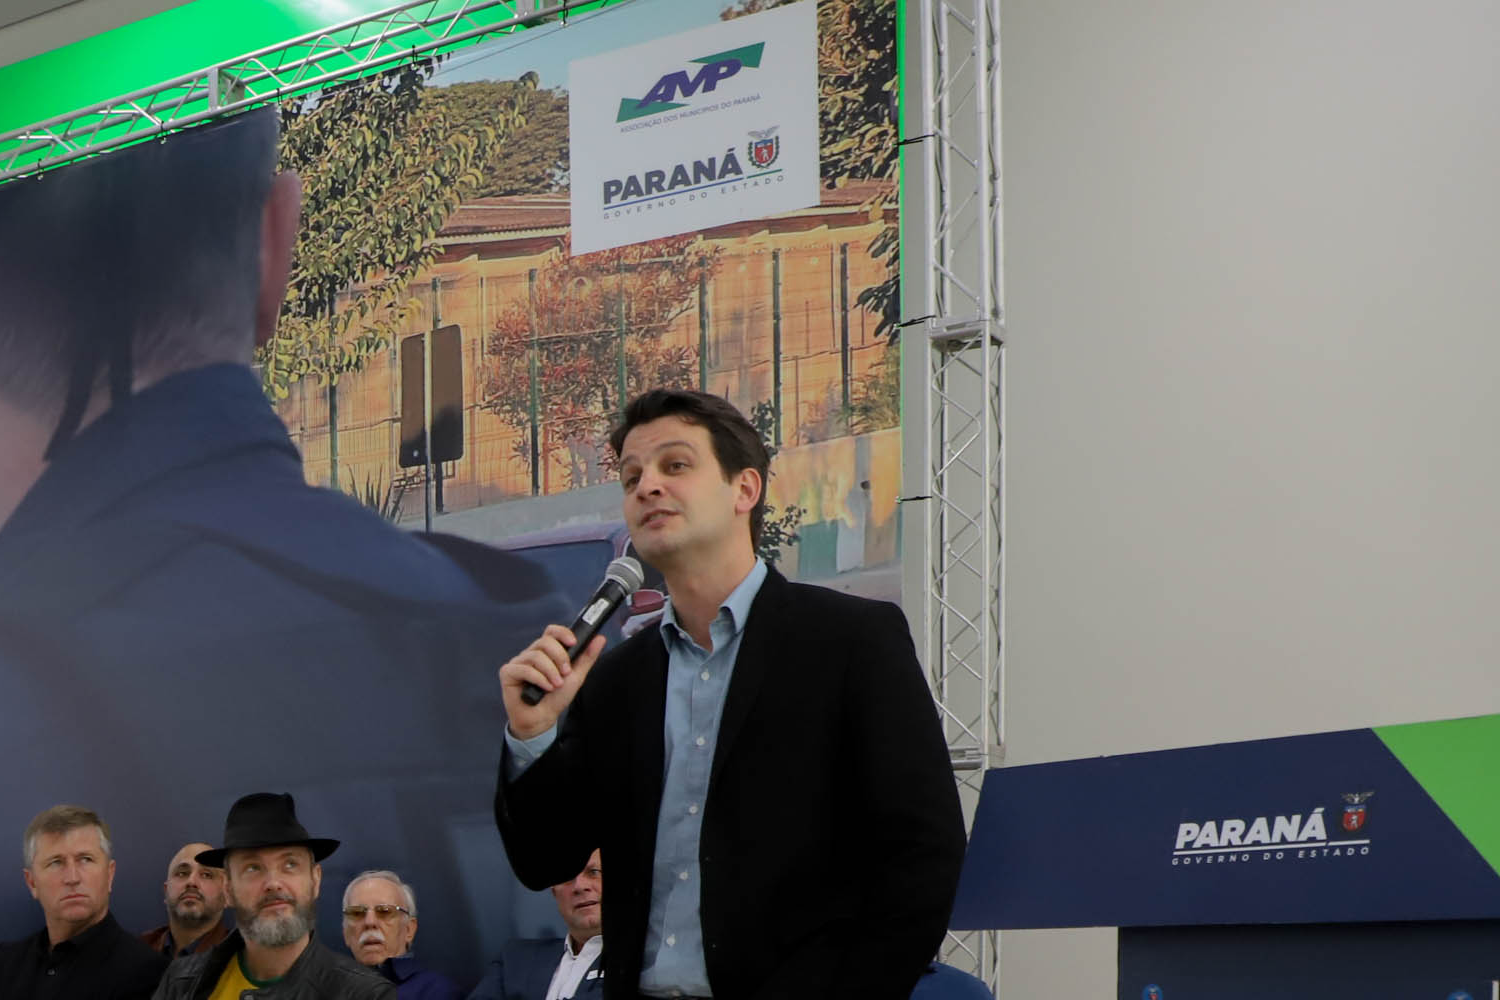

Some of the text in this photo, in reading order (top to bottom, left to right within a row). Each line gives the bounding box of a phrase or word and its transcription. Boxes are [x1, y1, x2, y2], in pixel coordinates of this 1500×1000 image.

[636, 58, 743, 110] AMP
[620, 117, 662, 134] ASSOCIAÇÃO
[663, 113, 678, 124] DOS
[720, 101, 732, 111] DO
[603, 147, 743, 205] PARANÁ
[603, 175, 784, 220] GOVERNO DO ESTADO
[1175, 807, 1328, 850] PARANÁ
[1171, 846, 1370, 866] GOVERNO DO ESTADO
